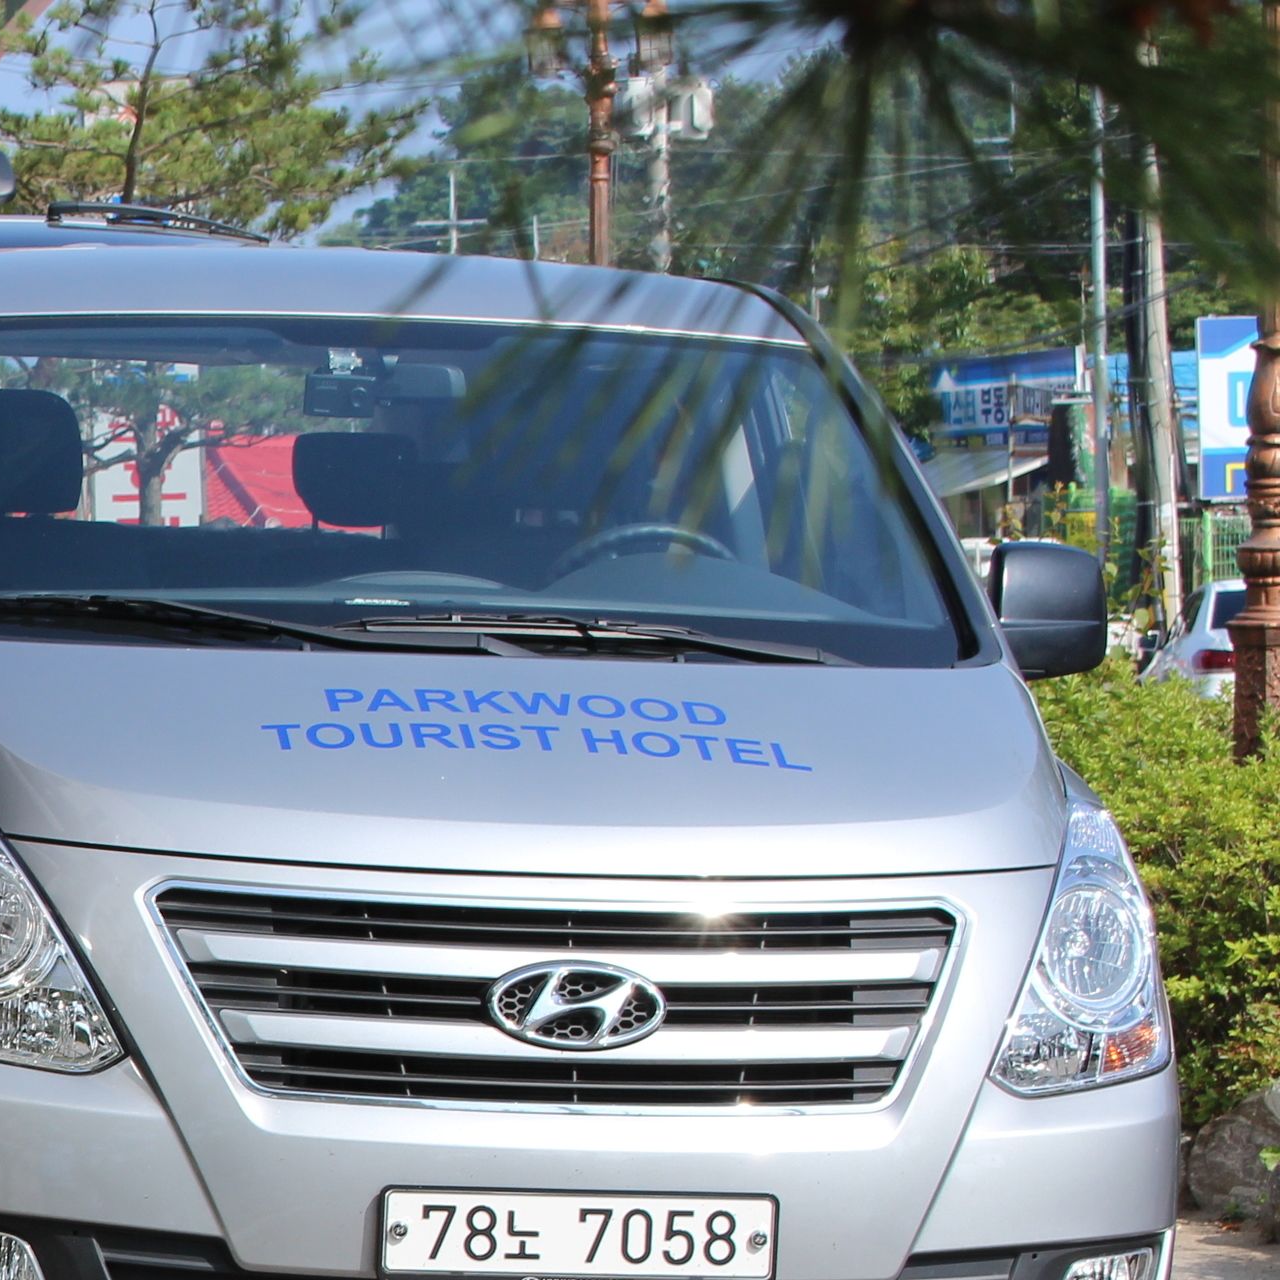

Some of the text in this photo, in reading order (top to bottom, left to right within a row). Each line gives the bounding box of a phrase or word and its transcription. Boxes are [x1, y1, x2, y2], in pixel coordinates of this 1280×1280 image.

[322, 687, 729, 727] PARKWOOD
[260, 720, 815, 773] TOURIST HOTEL
[421, 1204, 737, 1266] 78노 7058
